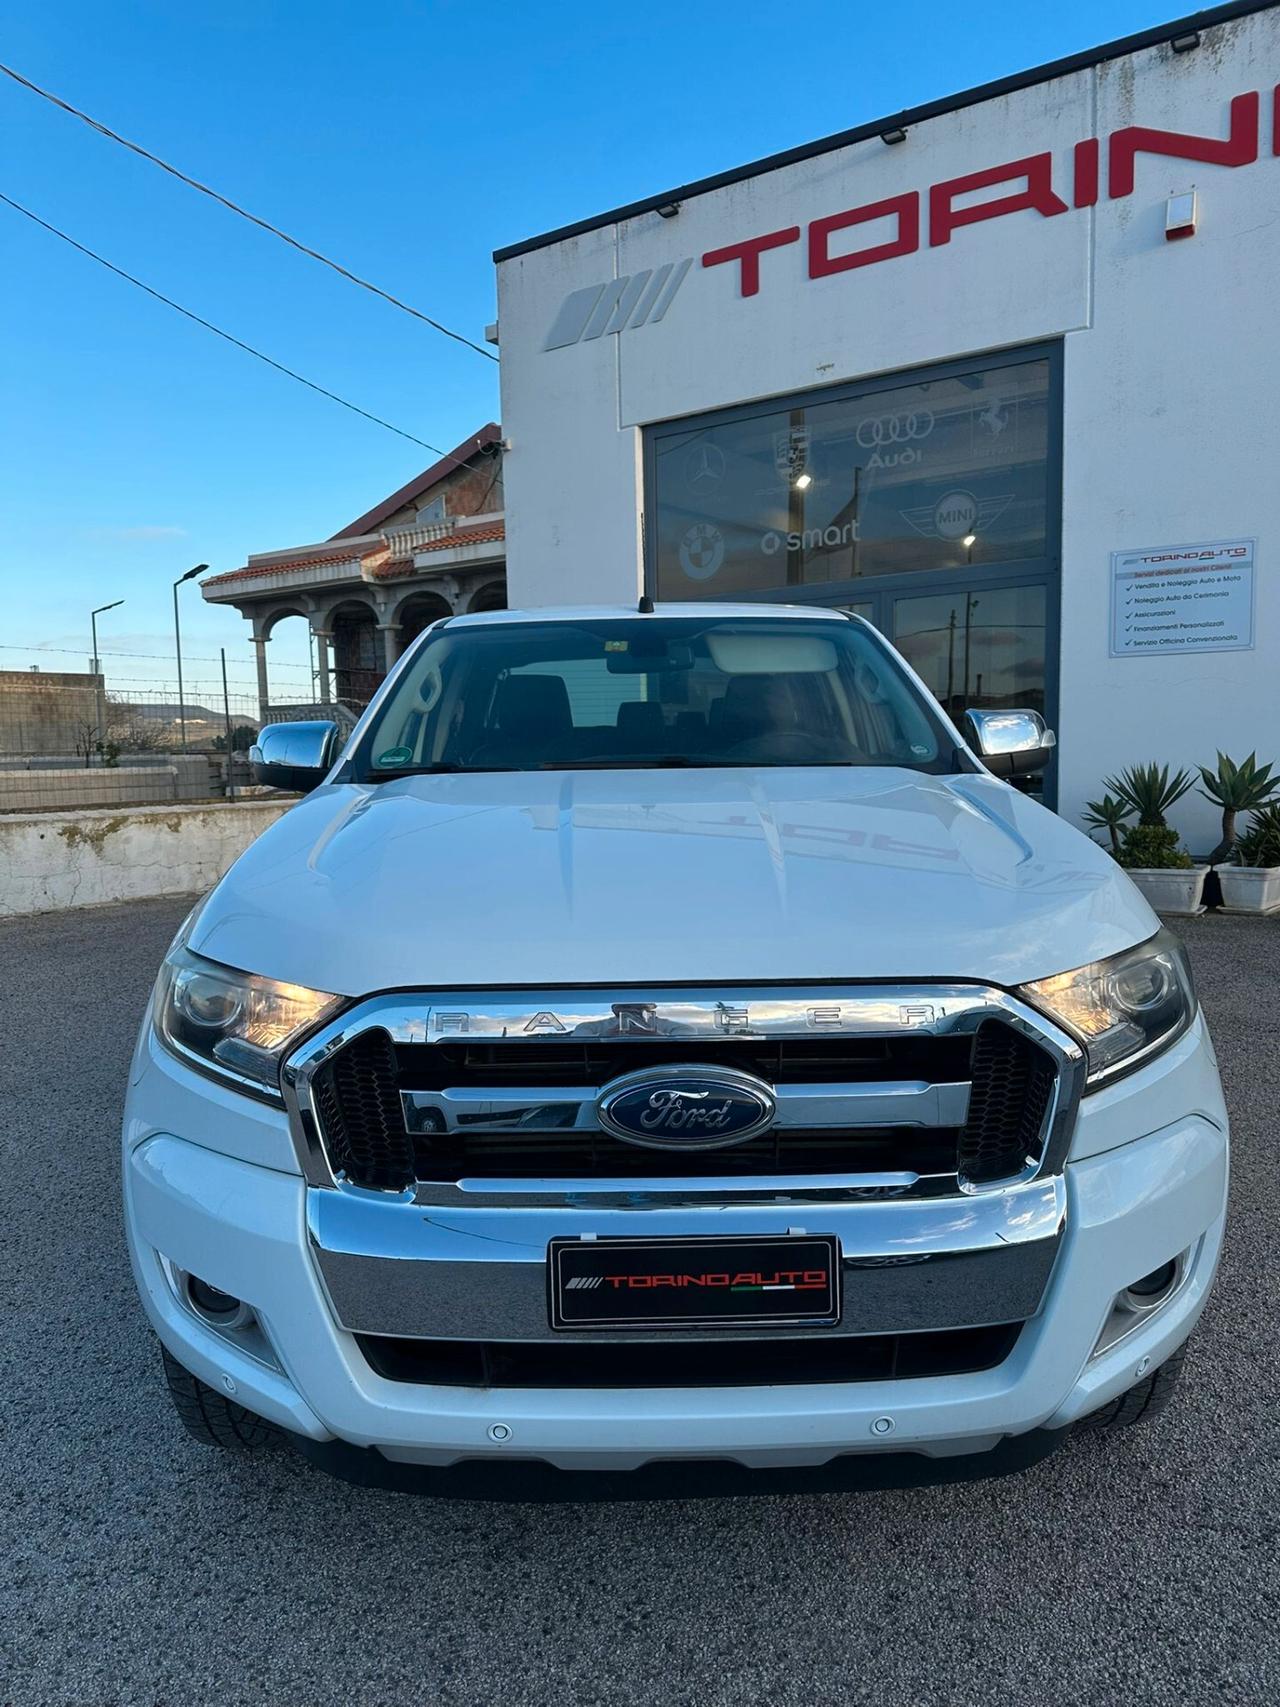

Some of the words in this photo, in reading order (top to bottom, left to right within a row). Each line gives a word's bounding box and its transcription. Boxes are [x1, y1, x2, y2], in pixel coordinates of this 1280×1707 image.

[702, 82, 1280, 298] TORIN
[866, 448, 922, 471] Audi
[938, 508, 973, 525] MINI
[787, 518, 861, 551] smart
[1141, 547, 1247, 564] TORINOAUTO
[434, 1003, 937, 1034] RANGER
[640, 1089, 730, 1129] Ford
[605, 1270, 826, 1289] TORINOAUTO
